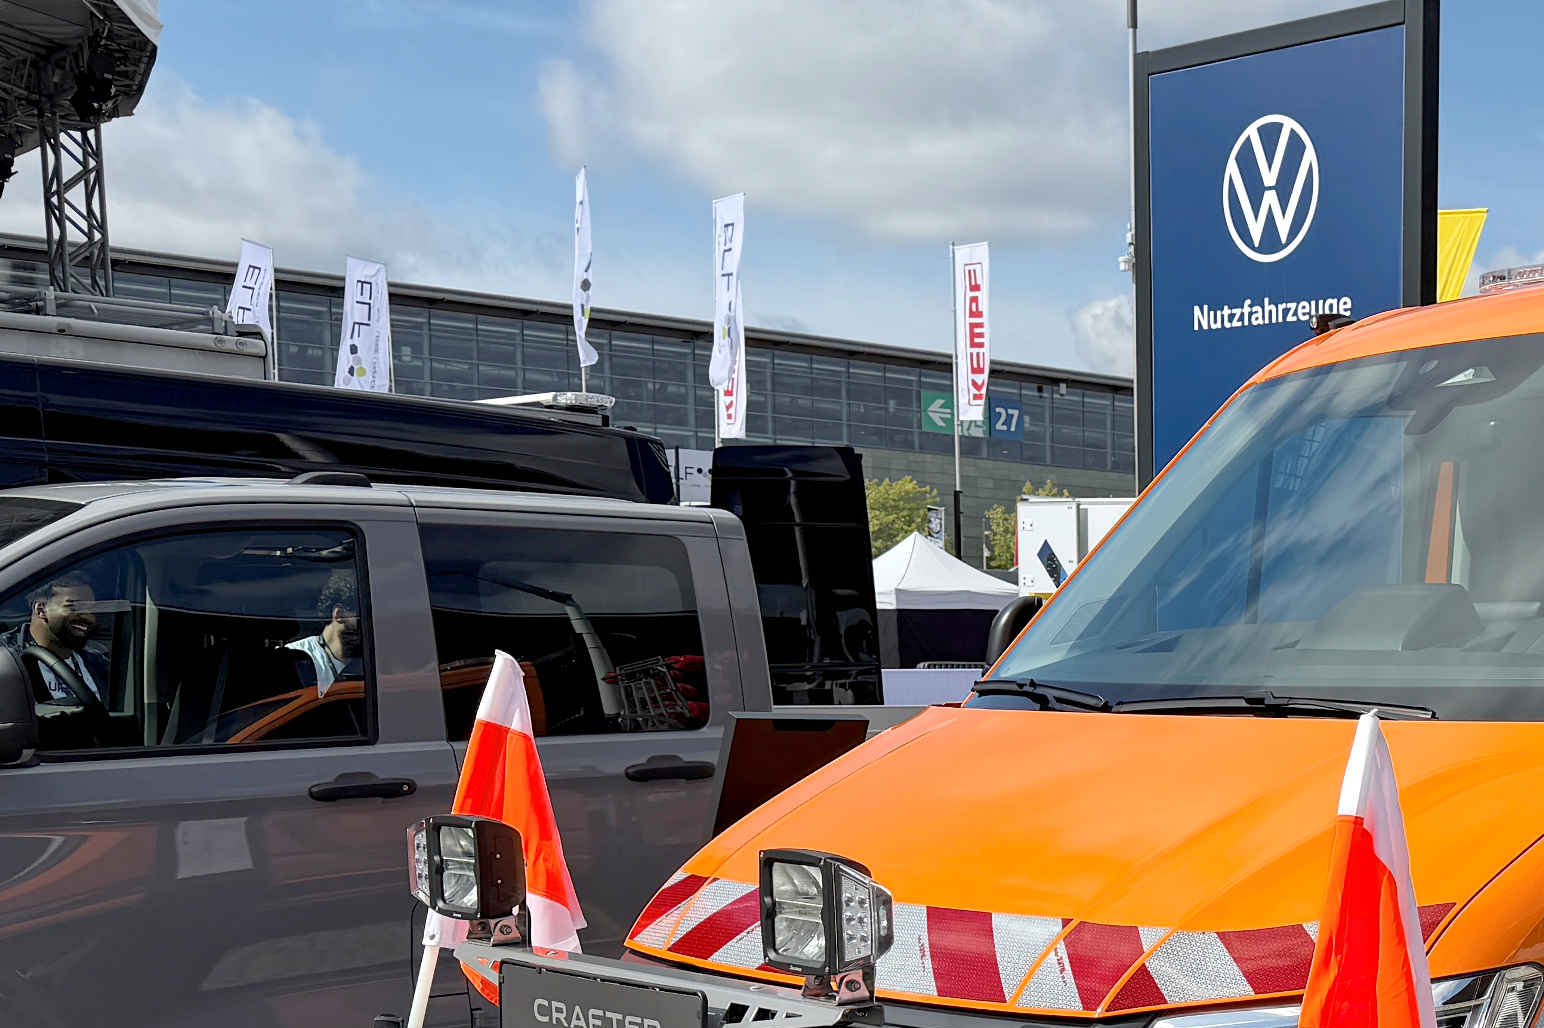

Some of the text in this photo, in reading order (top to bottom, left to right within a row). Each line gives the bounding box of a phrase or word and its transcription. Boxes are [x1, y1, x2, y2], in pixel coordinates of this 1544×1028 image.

[1193, 297, 1352, 331] Nutzfahrzeuge
[968, 269, 985, 401] KEMPF
[995, 407, 1020, 432] 27
